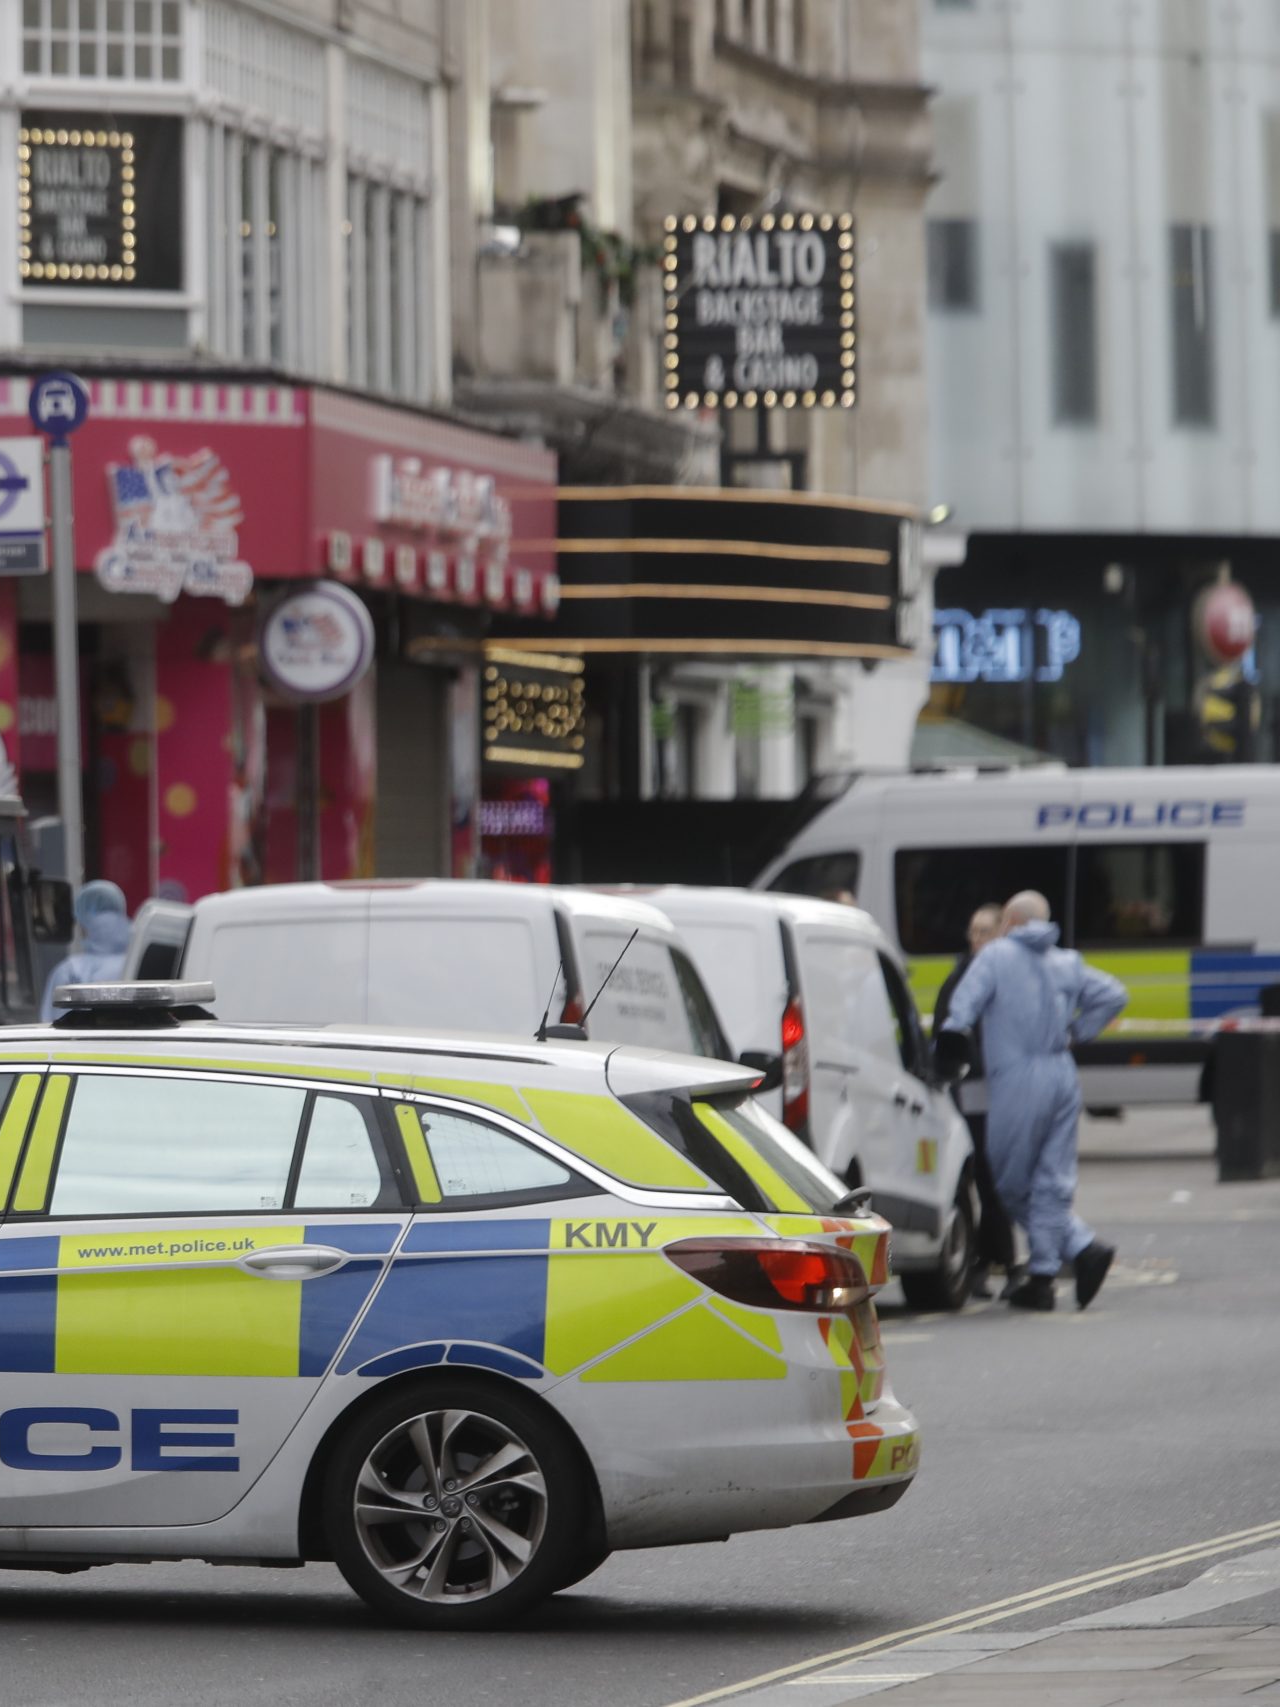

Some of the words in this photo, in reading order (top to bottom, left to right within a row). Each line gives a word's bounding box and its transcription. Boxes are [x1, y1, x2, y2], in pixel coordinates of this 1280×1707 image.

[34, 149, 111, 188] RIALTO
[694, 232, 825, 287] RIALTO
[696, 289, 824, 326] BACKSTAGE
[736, 326, 784, 353] BAR
[704, 353, 725, 391] &
[733, 353, 818, 391] CASINO
[1036, 800, 1246, 830] POLICE
[78, 1237, 255, 1259] www.met.police.uk
[565, 1222, 658, 1248] KMY
